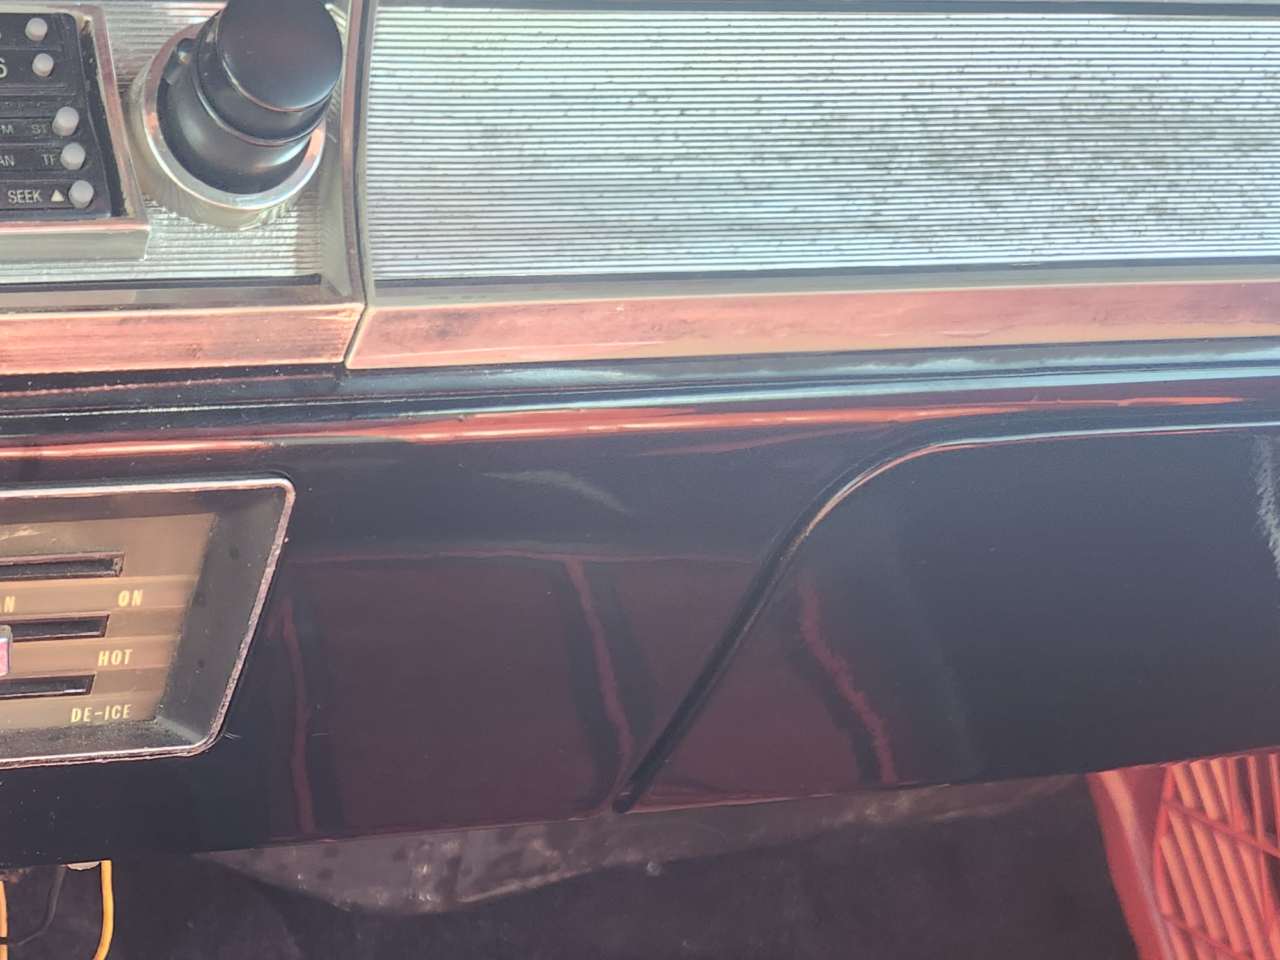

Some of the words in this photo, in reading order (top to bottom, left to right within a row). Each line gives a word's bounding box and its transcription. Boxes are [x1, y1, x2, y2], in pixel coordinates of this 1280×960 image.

[7, 189, 42, 204] SEEK
[118, 589, 143, 607] ON
[97, 648, 133, 667] HOT
[71, 704, 132, 723] DE-ICE
